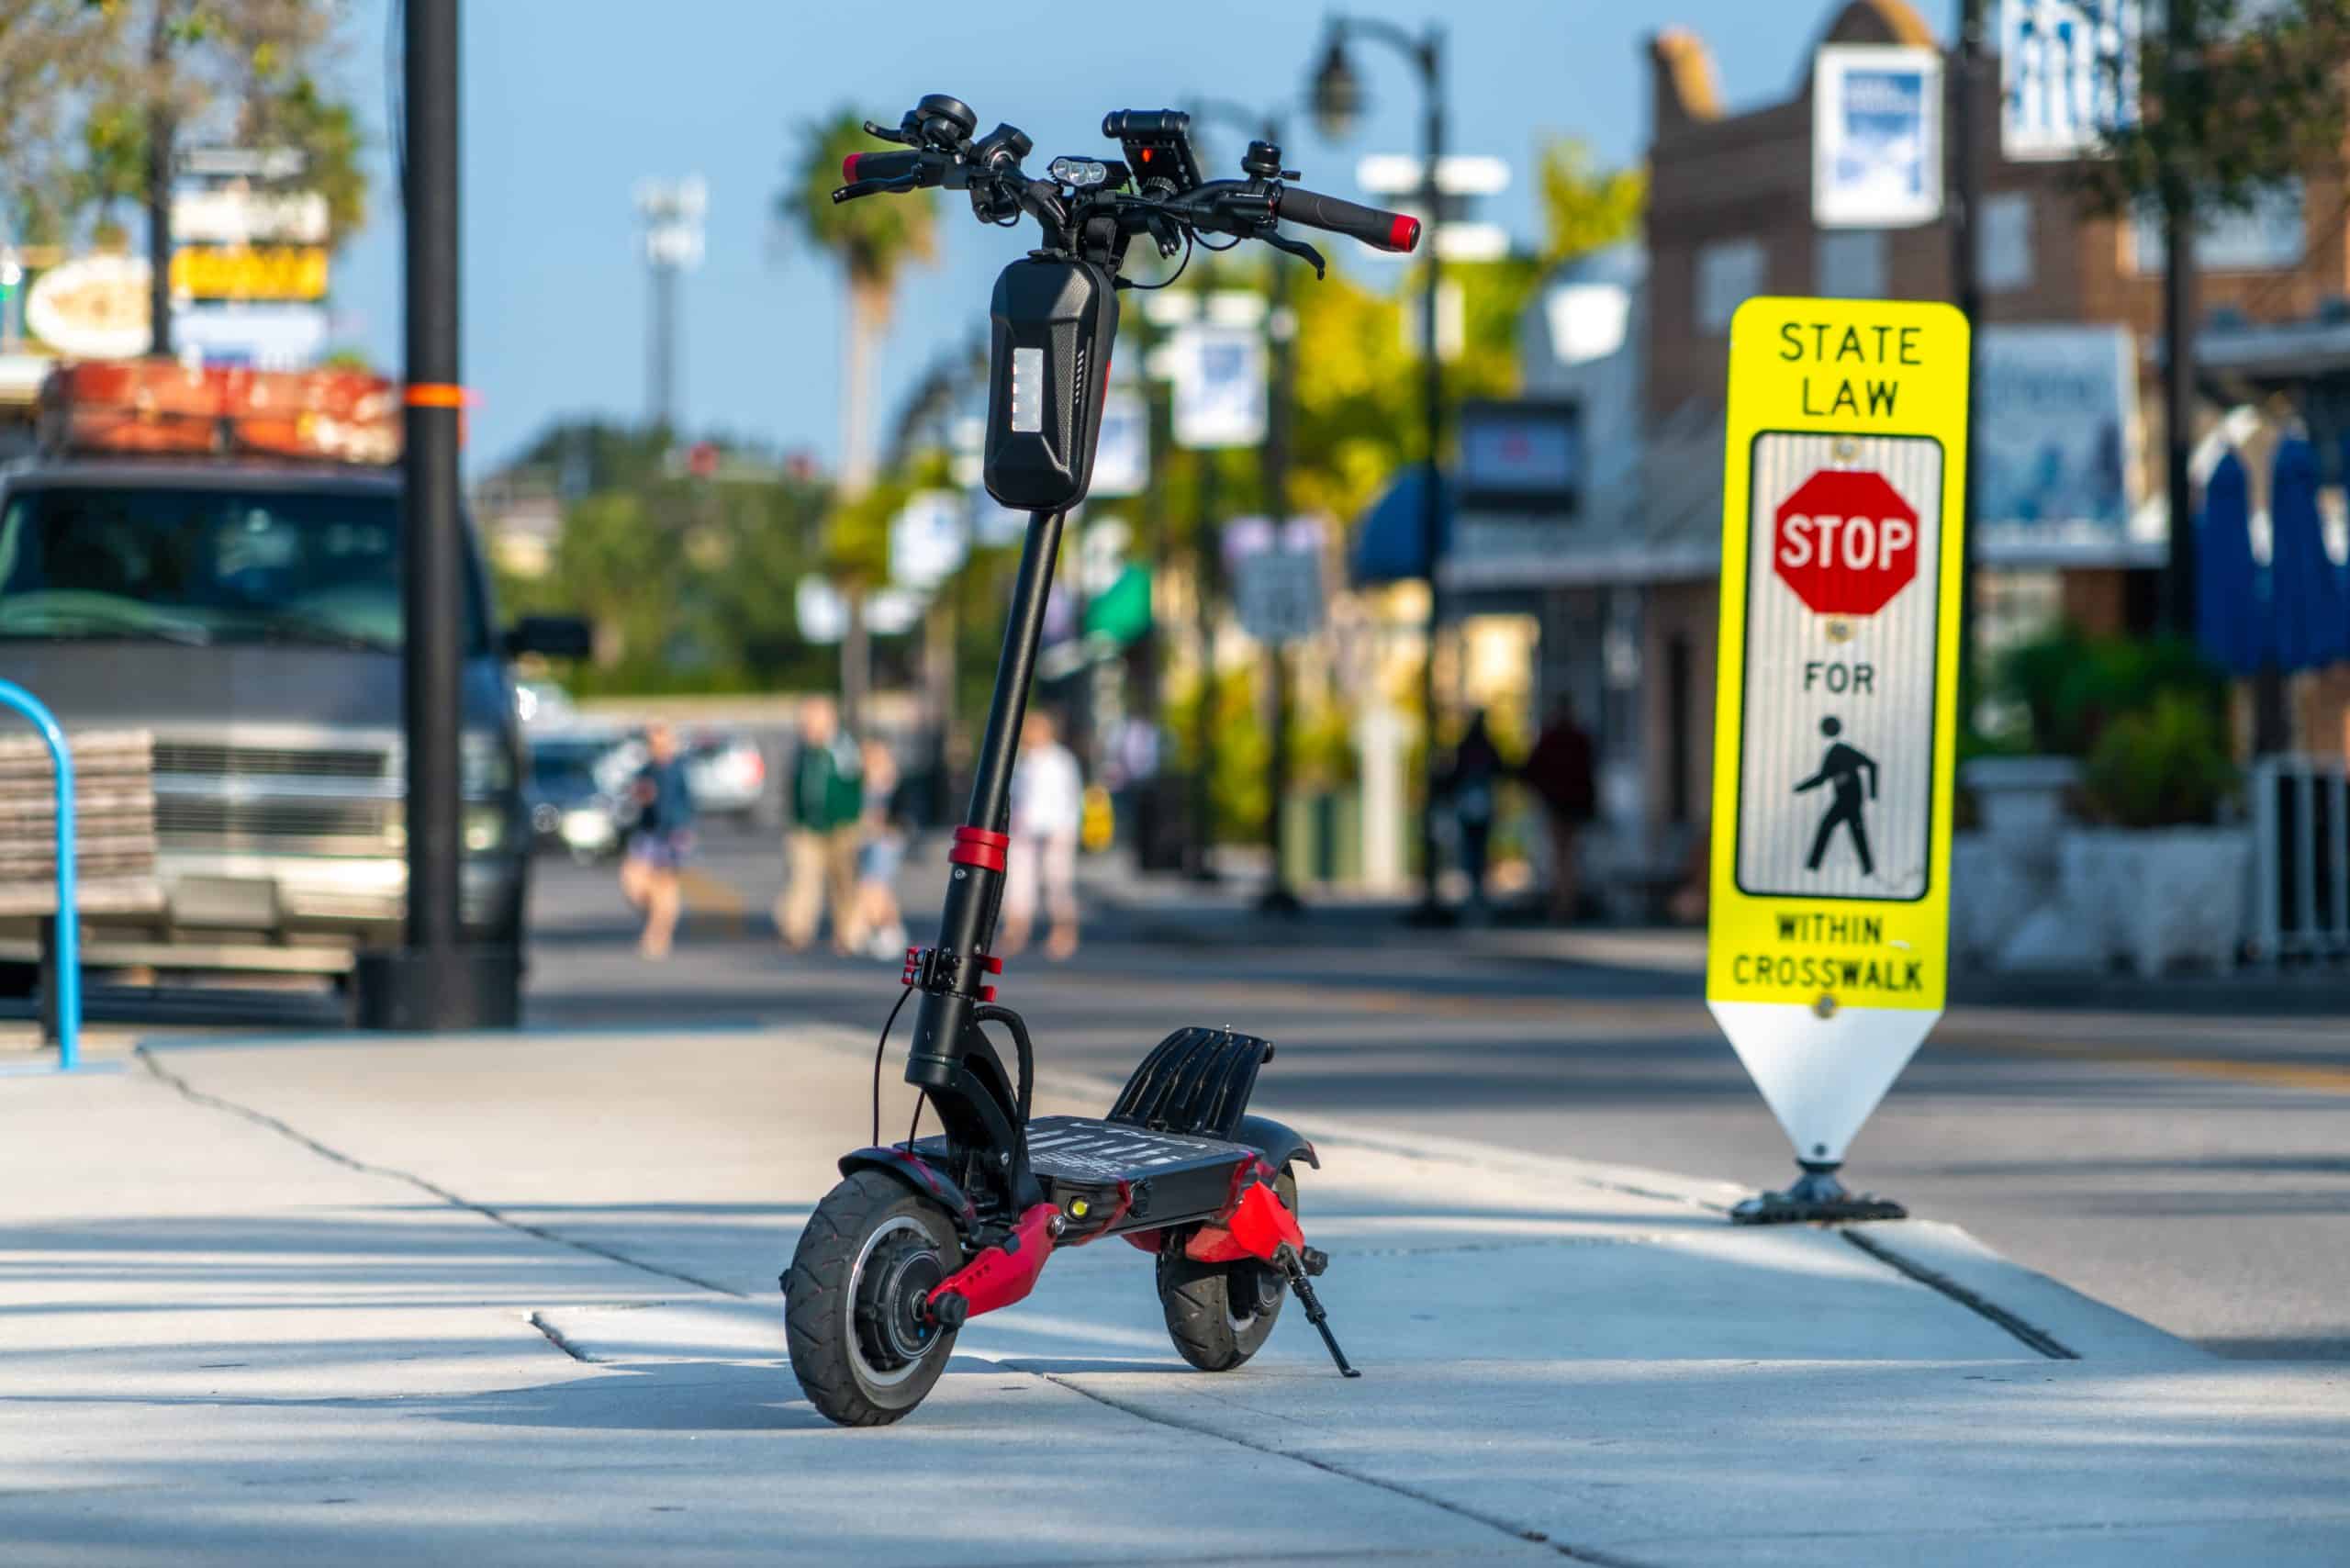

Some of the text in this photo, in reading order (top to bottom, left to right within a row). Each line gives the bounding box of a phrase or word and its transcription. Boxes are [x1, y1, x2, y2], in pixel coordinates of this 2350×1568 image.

[1780, 322, 1921, 365] STATE
[1803, 377, 1898, 418] LAW
[1780, 514, 1914, 571] STOP
[1804, 662, 1874, 694] FOR
[1777, 913, 1883, 945] WITHIN
[1734, 955, 1923, 992] CROSSWALK
